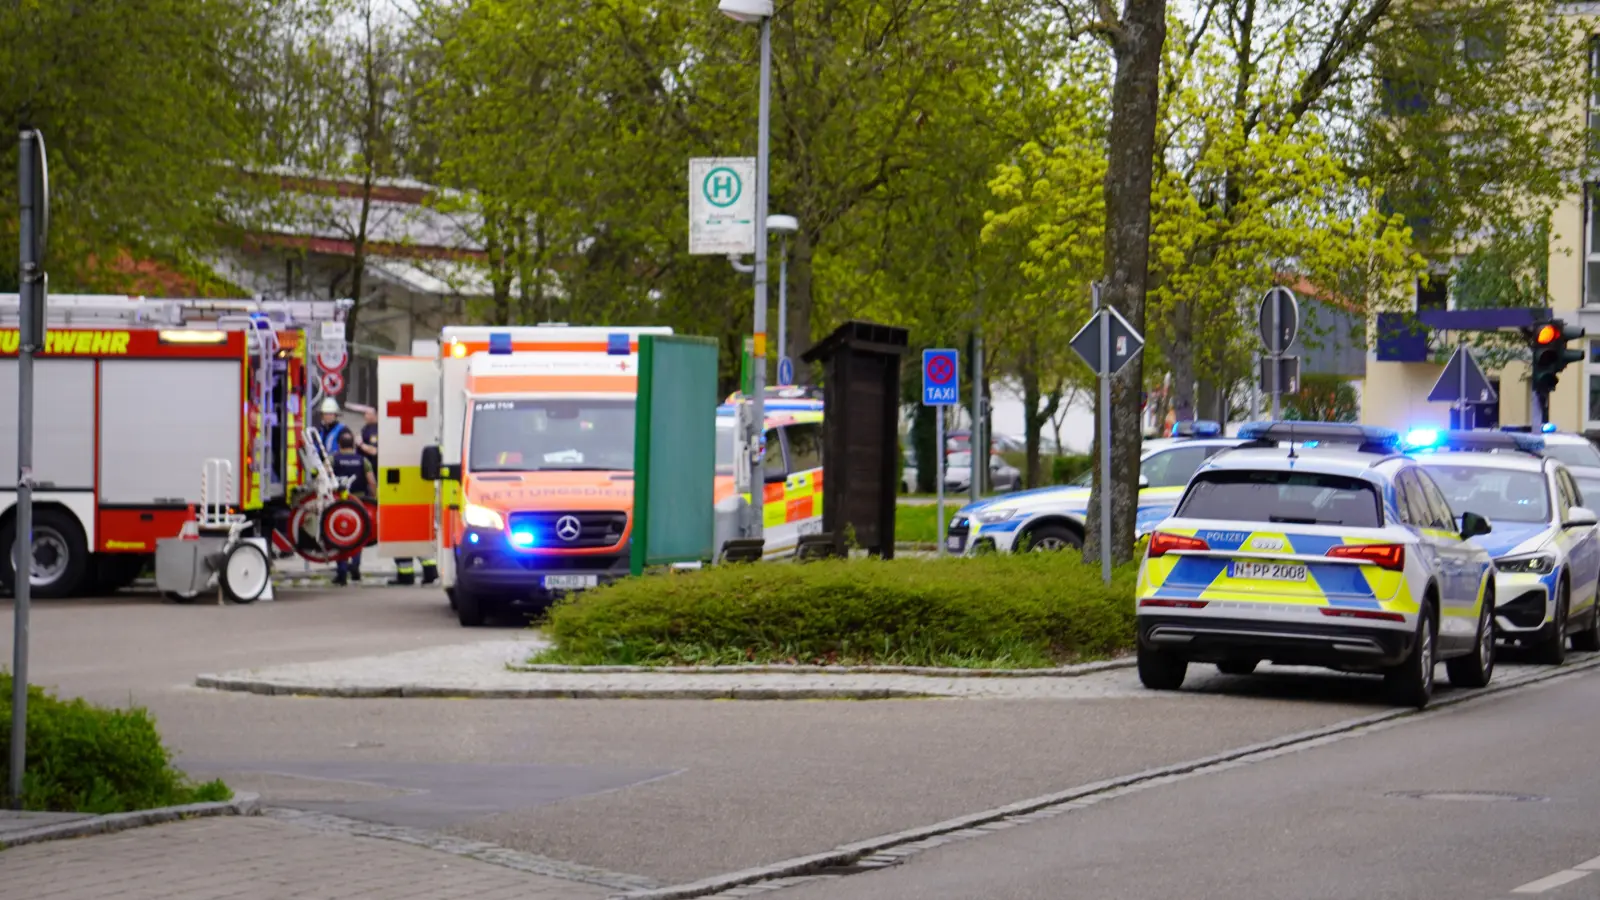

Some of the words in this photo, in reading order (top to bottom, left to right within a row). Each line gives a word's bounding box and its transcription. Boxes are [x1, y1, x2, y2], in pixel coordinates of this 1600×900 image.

[713, 176, 731, 198] H
[926, 387, 955, 400] TAXI
[480, 487, 634, 503] RETTUNGSDIEN
[1206, 531, 1245, 543] POLIZEI
[1235, 562, 1244, 576] N
[1253, 563, 1270, 577] PP
[1272, 564, 1305, 579] 2008
